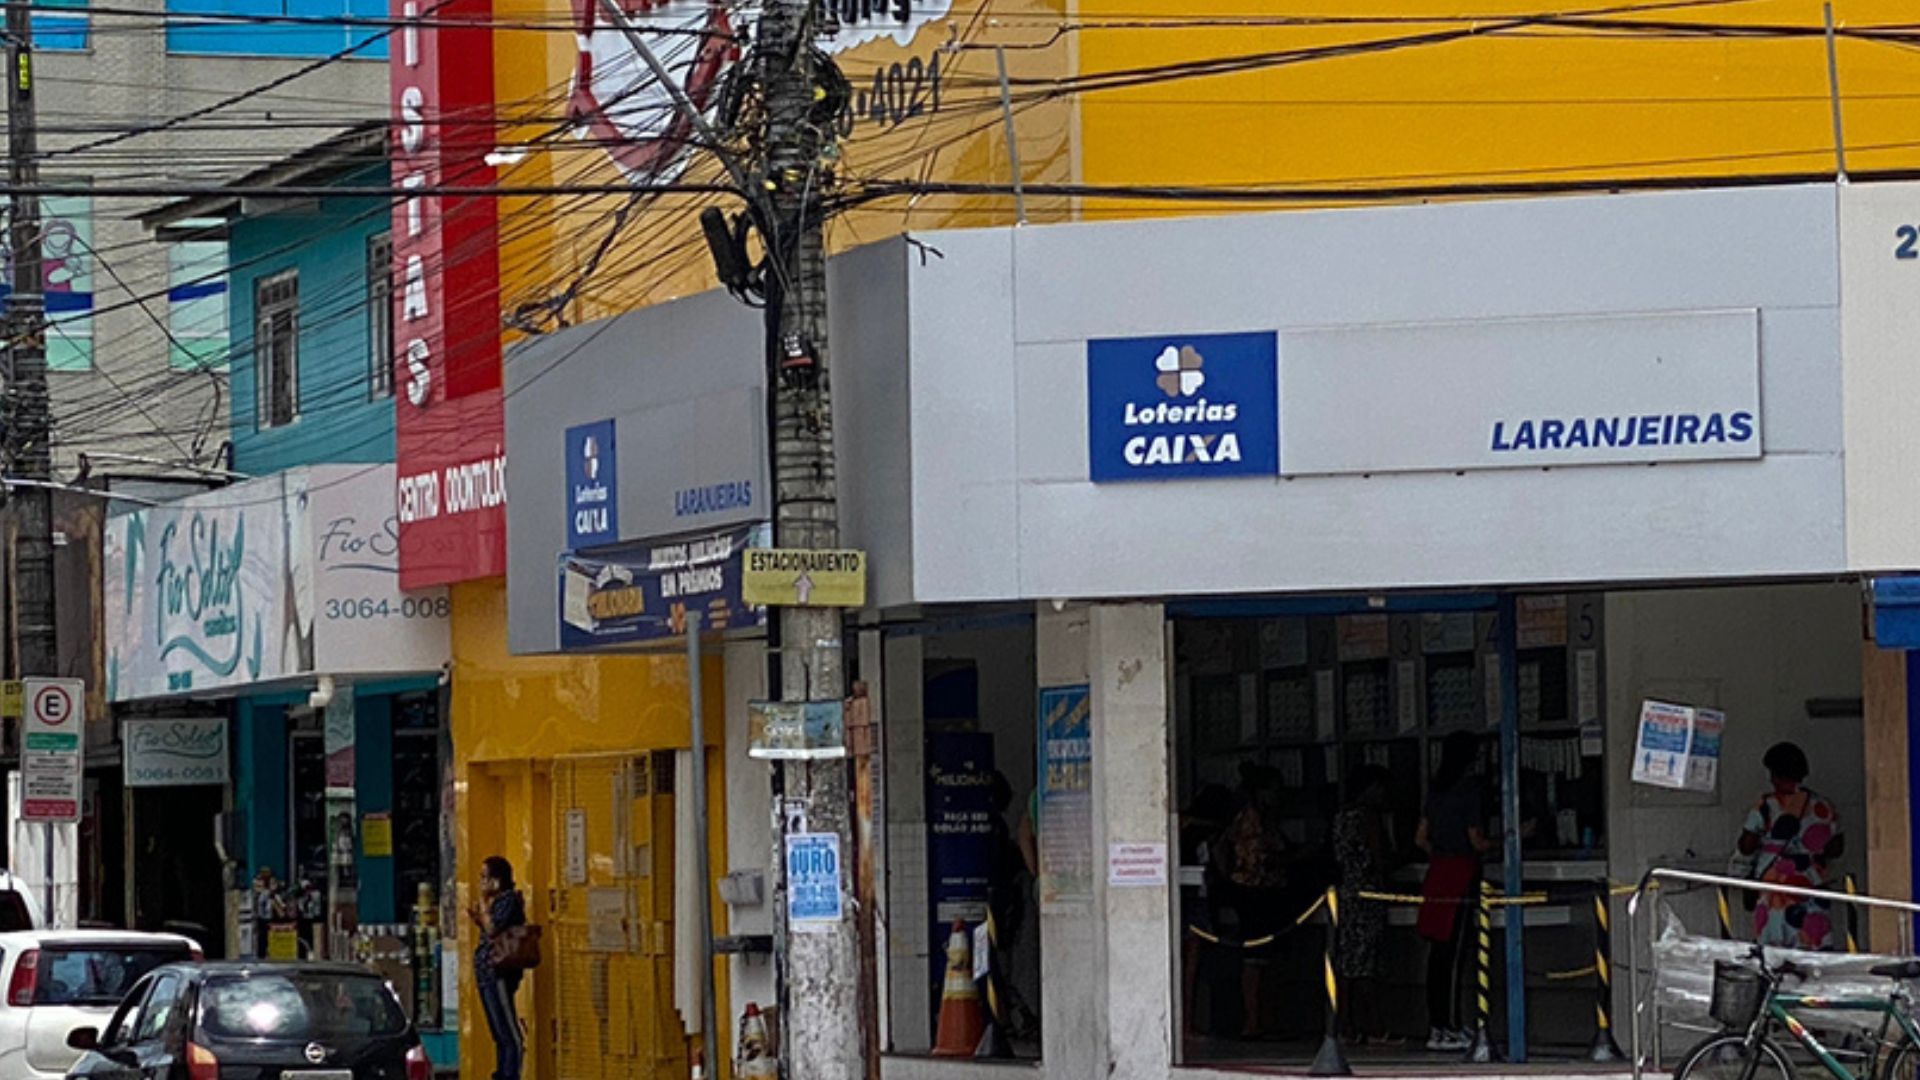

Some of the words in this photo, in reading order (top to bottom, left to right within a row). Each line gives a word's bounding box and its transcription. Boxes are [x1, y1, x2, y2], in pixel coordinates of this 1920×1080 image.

[1895, 223, 1920, 260] 2
[1124, 398, 1237, 425] Loterias
[1124, 433, 1241, 465] CAIXA
[1491, 411, 1753, 451] LARANJEIRAS
[400, 469, 439, 523] CENTRO
[575, 482, 607, 504] Loterias
[674, 480, 751, 516] LARANJEIRAS
[319, 517, 366, 561] Fio
[751, 552, 860, 572] ESTACIONAMENTO
[1578, 602, 1596, 641] 5
[45, 694, 60, 716] E
